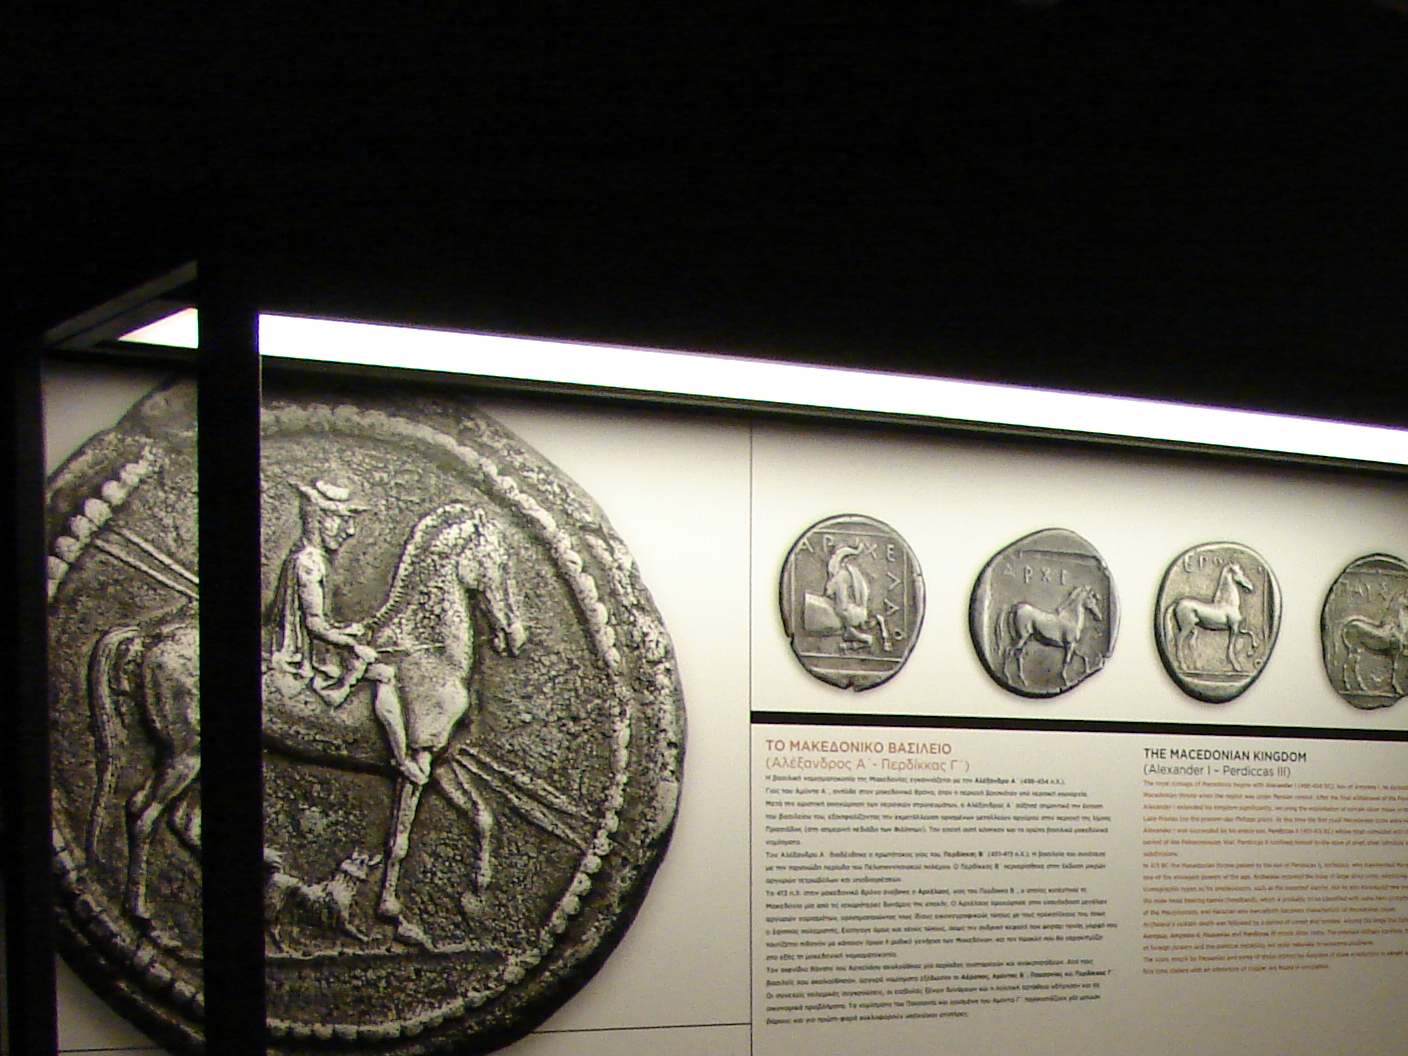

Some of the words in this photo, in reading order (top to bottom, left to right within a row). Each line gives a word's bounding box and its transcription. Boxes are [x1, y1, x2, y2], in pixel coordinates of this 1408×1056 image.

[766, 739, 785, 752] ΤΟ
[789, 740, 884, 754] ΜΑΚΕΔΟΝΙΚΟ
[888, 742, 953, 755] ΒΑΣΙΛΕΙΟ
[1144, 748, 1166, 760] THE
[1170, 749, 1251, 762] MACEDONIAN
[1253, 751, 1307, 763] KINGDOM
[765, 757, 852, 771] (Αλέξανδρος
[881, 758, 946, 772] Περδίκκας
[1143, 764, 1204, 777] (Alexander
[1222, 765, 1274, 778] Perdiccas
